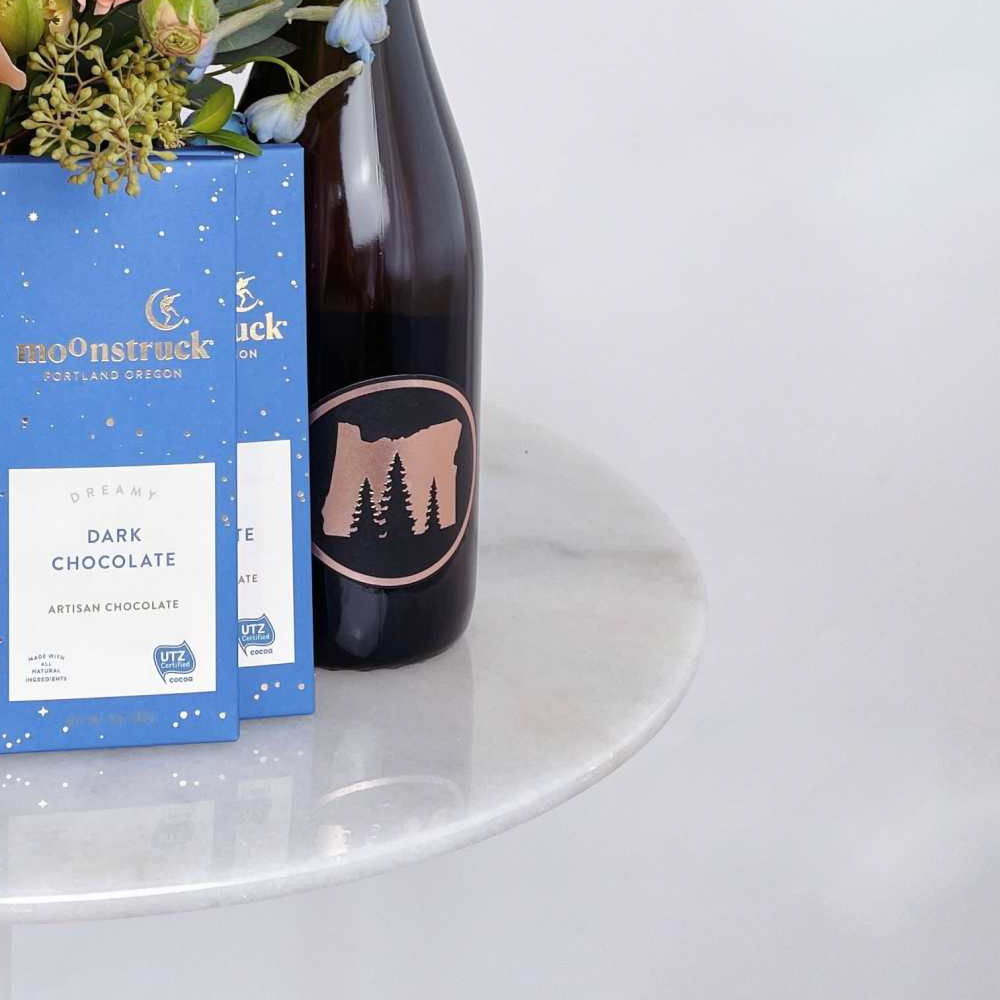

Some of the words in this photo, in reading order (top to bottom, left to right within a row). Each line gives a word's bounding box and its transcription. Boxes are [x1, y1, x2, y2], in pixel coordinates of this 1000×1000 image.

[15, 330, 216, 364] moonstruck
[43, 370, 119, 382] PORTLAND
[124, 368, 183, 380] OREGON
[70, 484, 157, 504] DREAMY
[87, 527, 142, 544] DARK
[51, 552, 176, 571] CHOCOLATE
[47, 603, 101, 614] ARTISAN
[104, 599, 179, 612] CHOCOLATE
[241, 623, 266, 635] UTZ
[241, 633, 270, 642] Certified
[160, 650, 186, 662] UTZ
[249, 648, 274, 656] cocoa
[168, 676, 194, 684] cocoa
